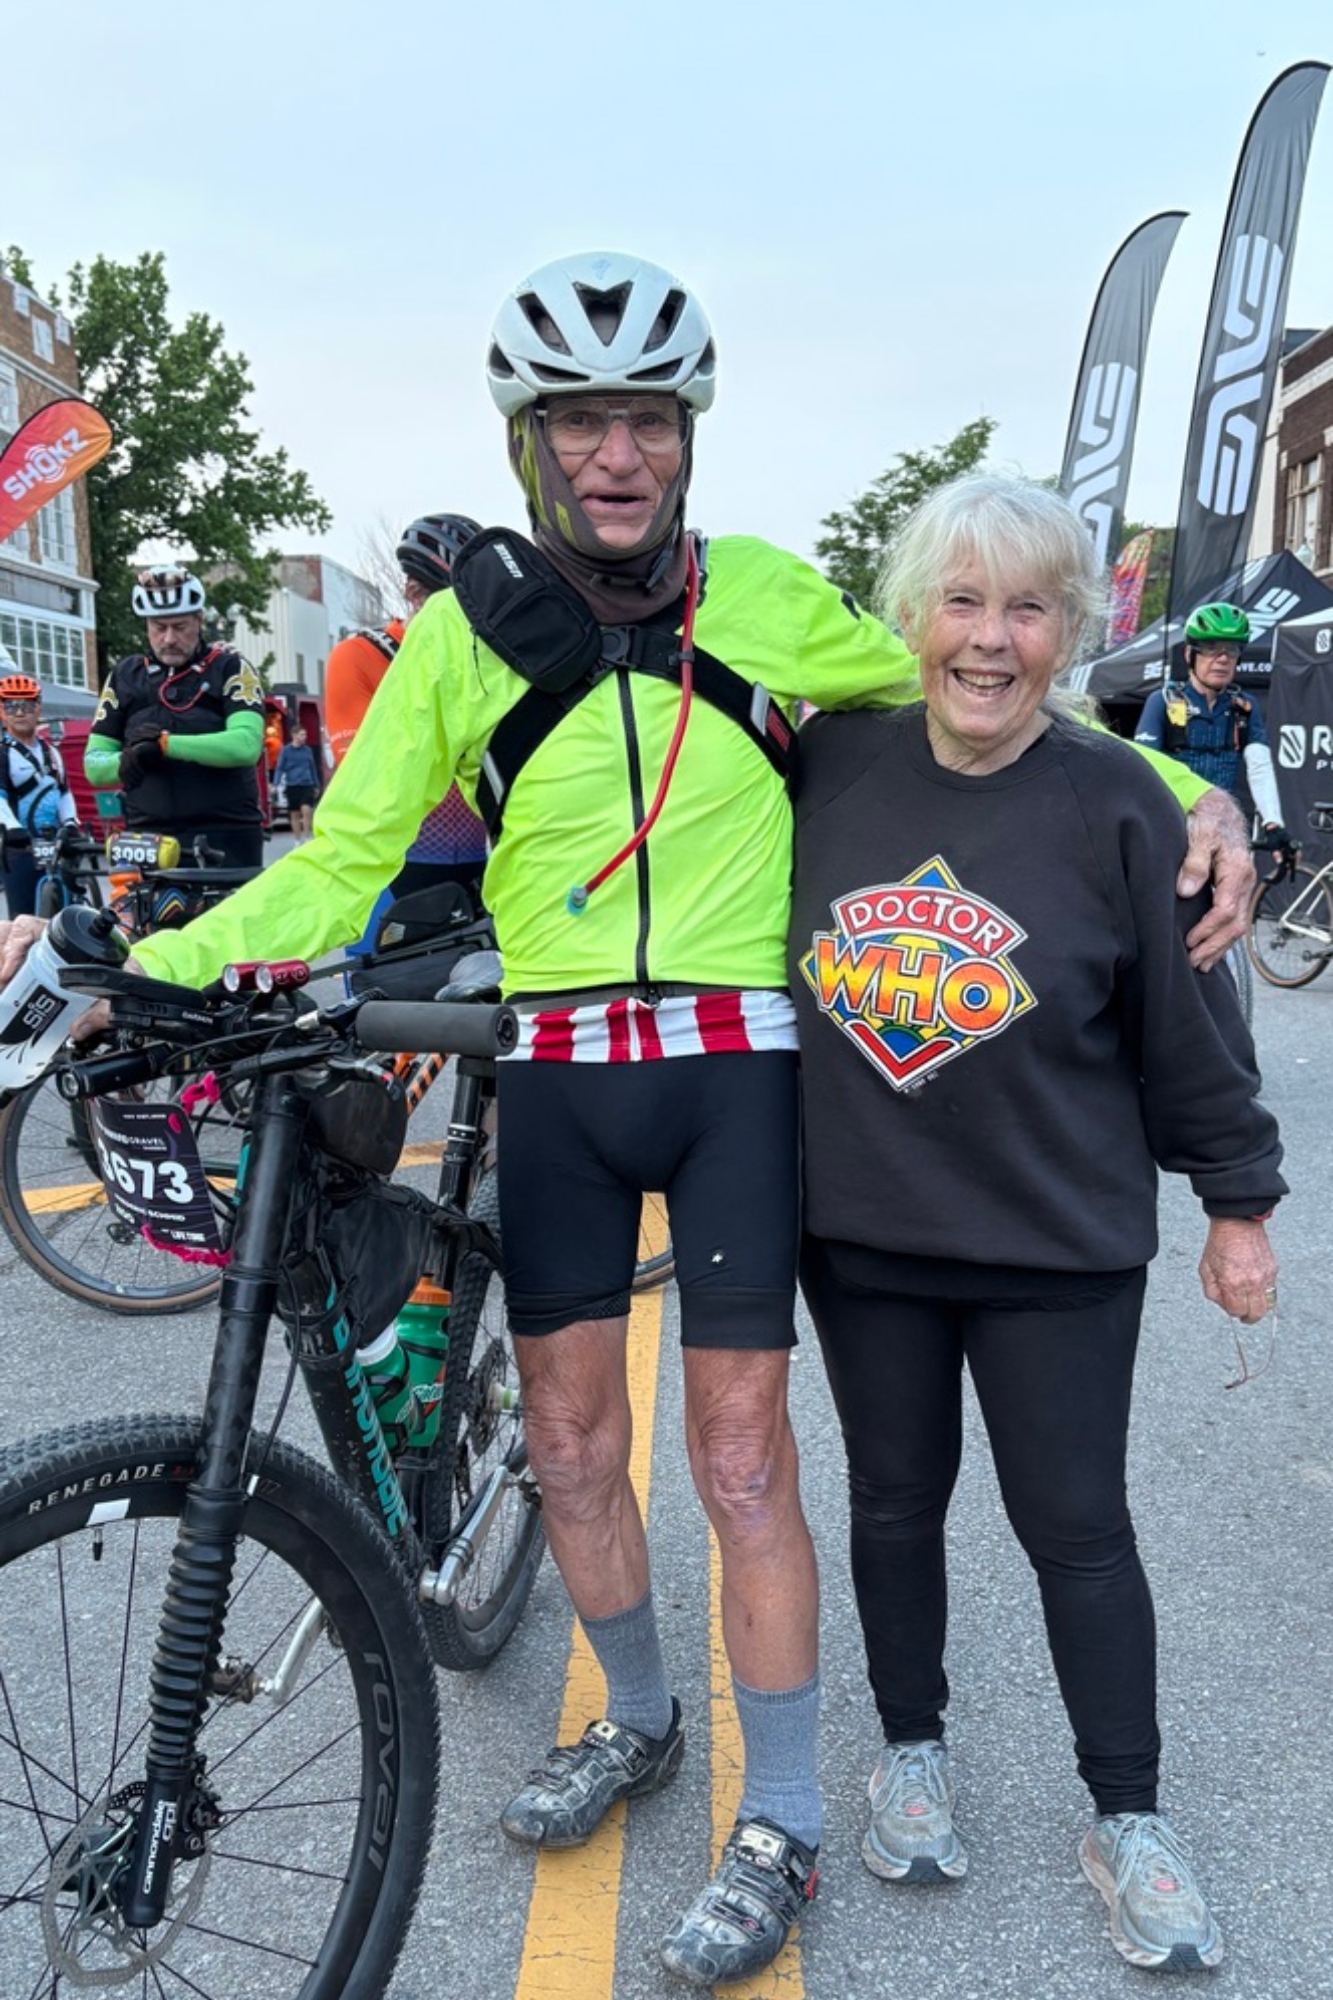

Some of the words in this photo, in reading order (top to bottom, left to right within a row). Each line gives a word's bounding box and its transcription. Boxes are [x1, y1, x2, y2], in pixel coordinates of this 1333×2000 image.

[3, 427, 89, 501] SHOKZ
[111, 846, 157, 863] 3005
[848, 896, 1004, 951] DOCTOR
[814, 934, 1016, 1036] WHO
[27, 1462, 166, 1516] RENEGADE
[363, 1652, 395, 1872] roval
[143, 1799, 166, 1895] cannondale
